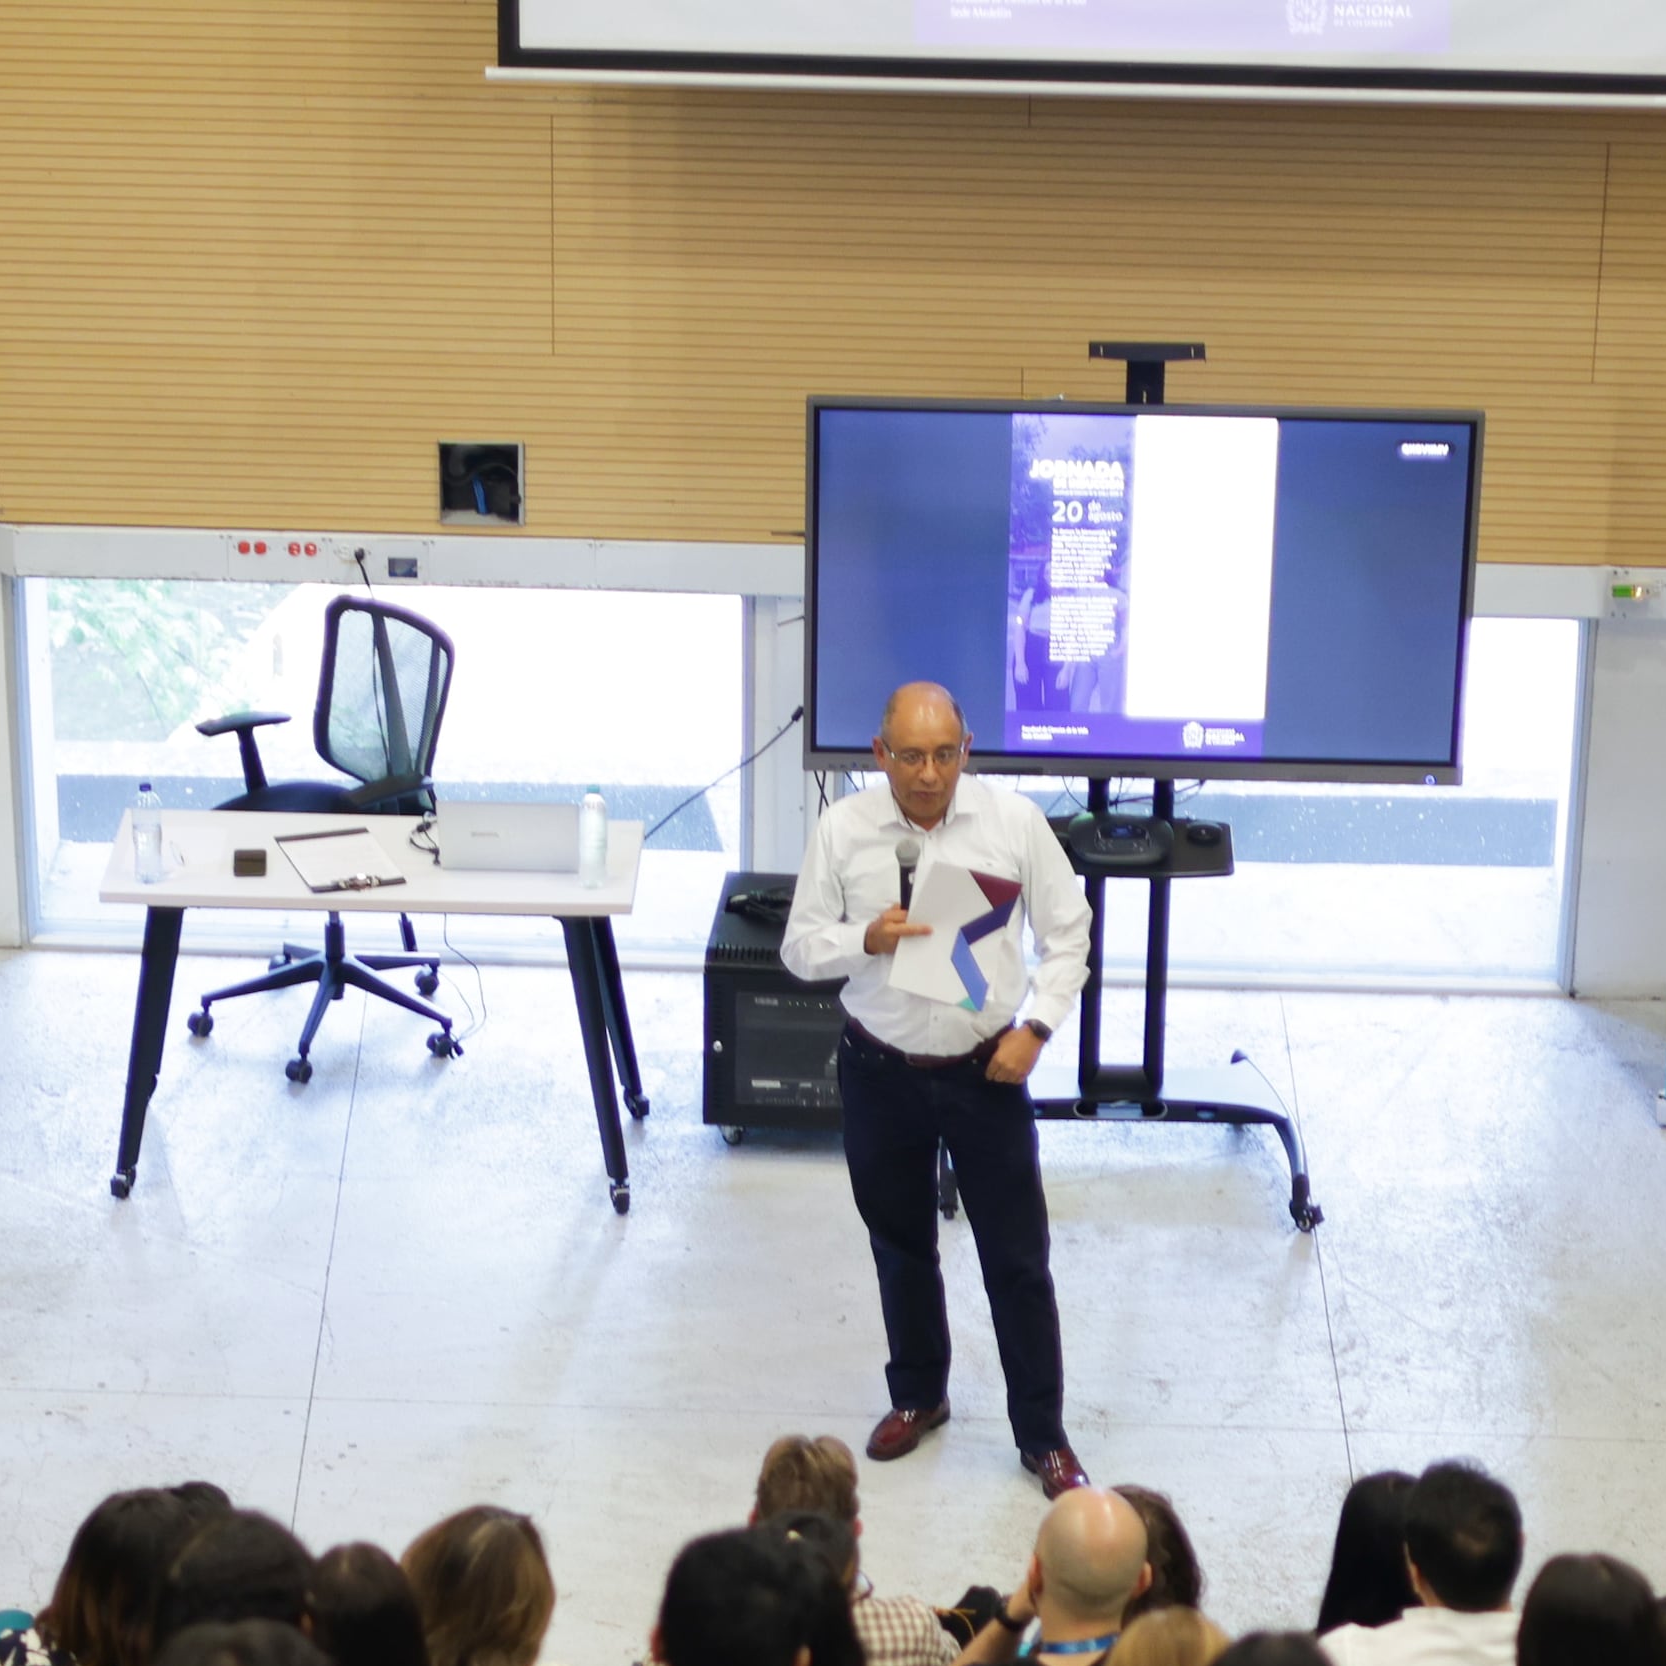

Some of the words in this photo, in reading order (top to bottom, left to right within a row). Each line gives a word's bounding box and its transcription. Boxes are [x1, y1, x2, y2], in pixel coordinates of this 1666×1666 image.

[1334, 3, 1413, 18] NACIONAL
[1029, 459, 1125, 480] JORNADA
[1052, 500, 1083, 523] 20
